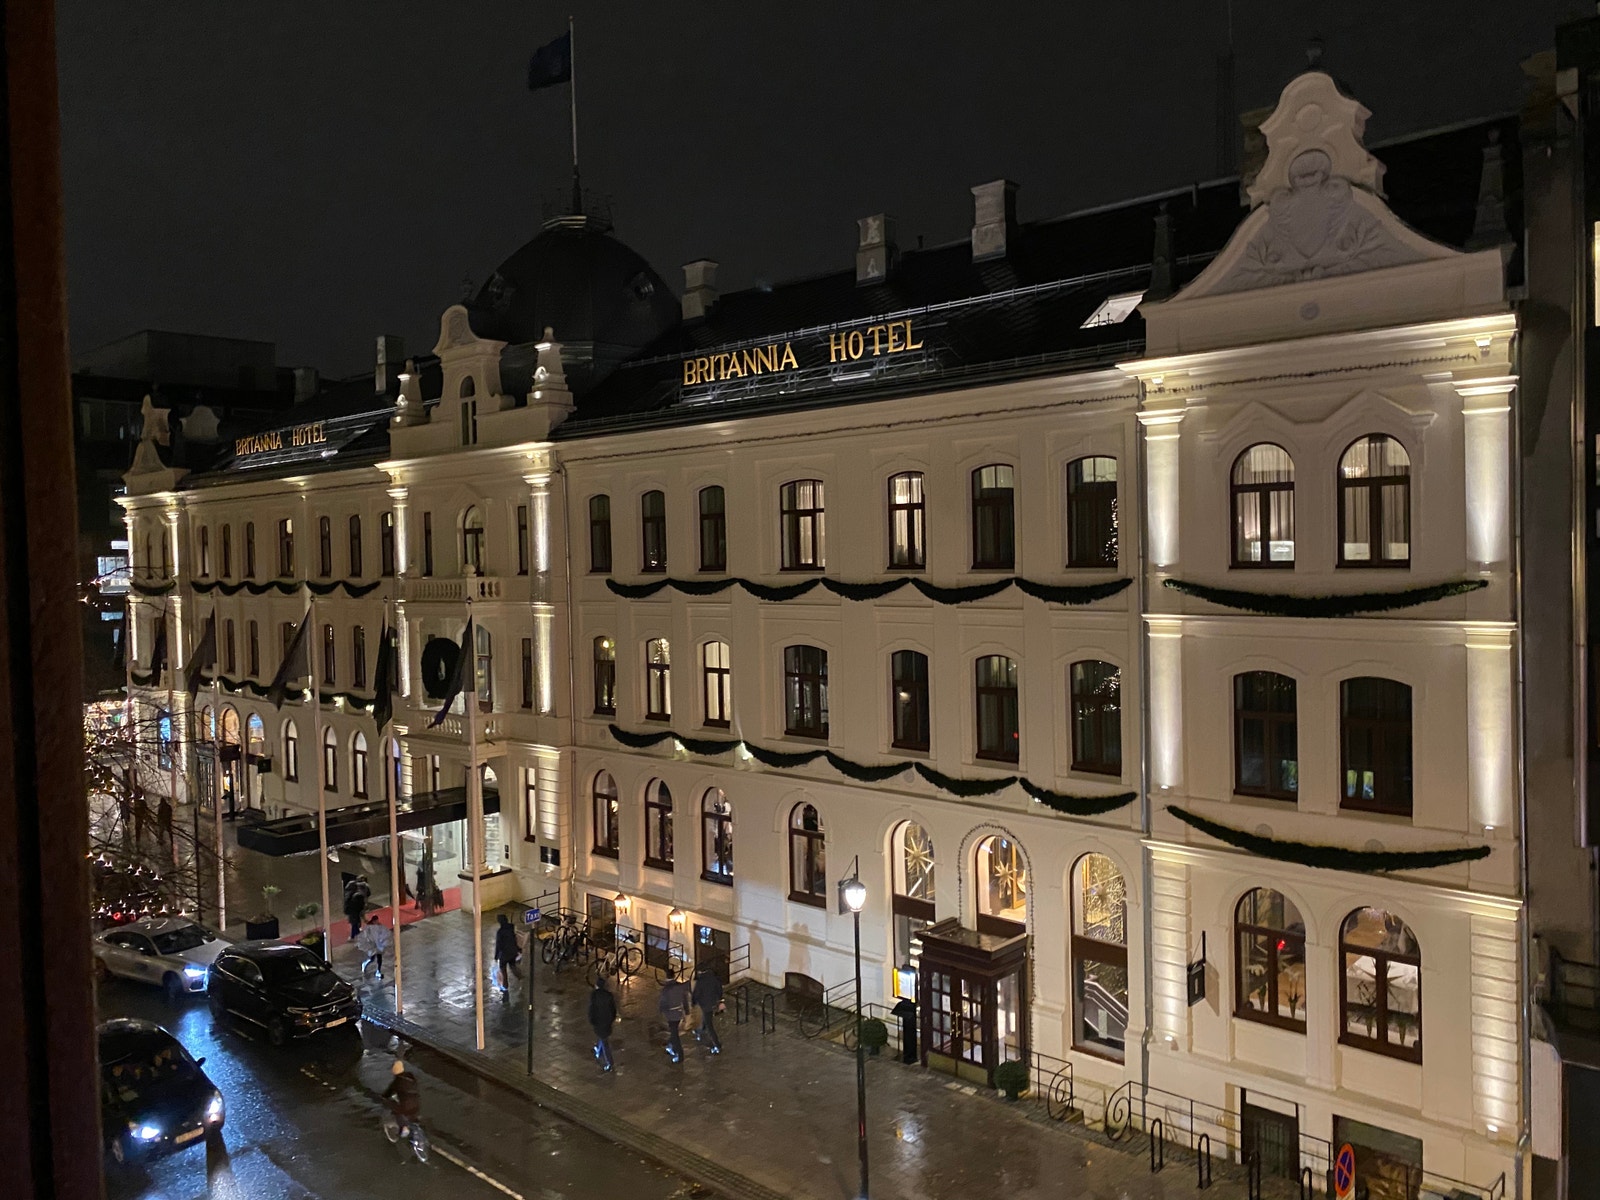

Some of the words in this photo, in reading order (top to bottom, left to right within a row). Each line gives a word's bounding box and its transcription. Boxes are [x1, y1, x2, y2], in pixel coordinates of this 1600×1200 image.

[683, 342, 798, 385] BRITANNIA
[829, 319, 923, 362] HOTEL
[235, 432, 282, 456] BRITANNIA
[292, 423, 326, 446] HOTEL
